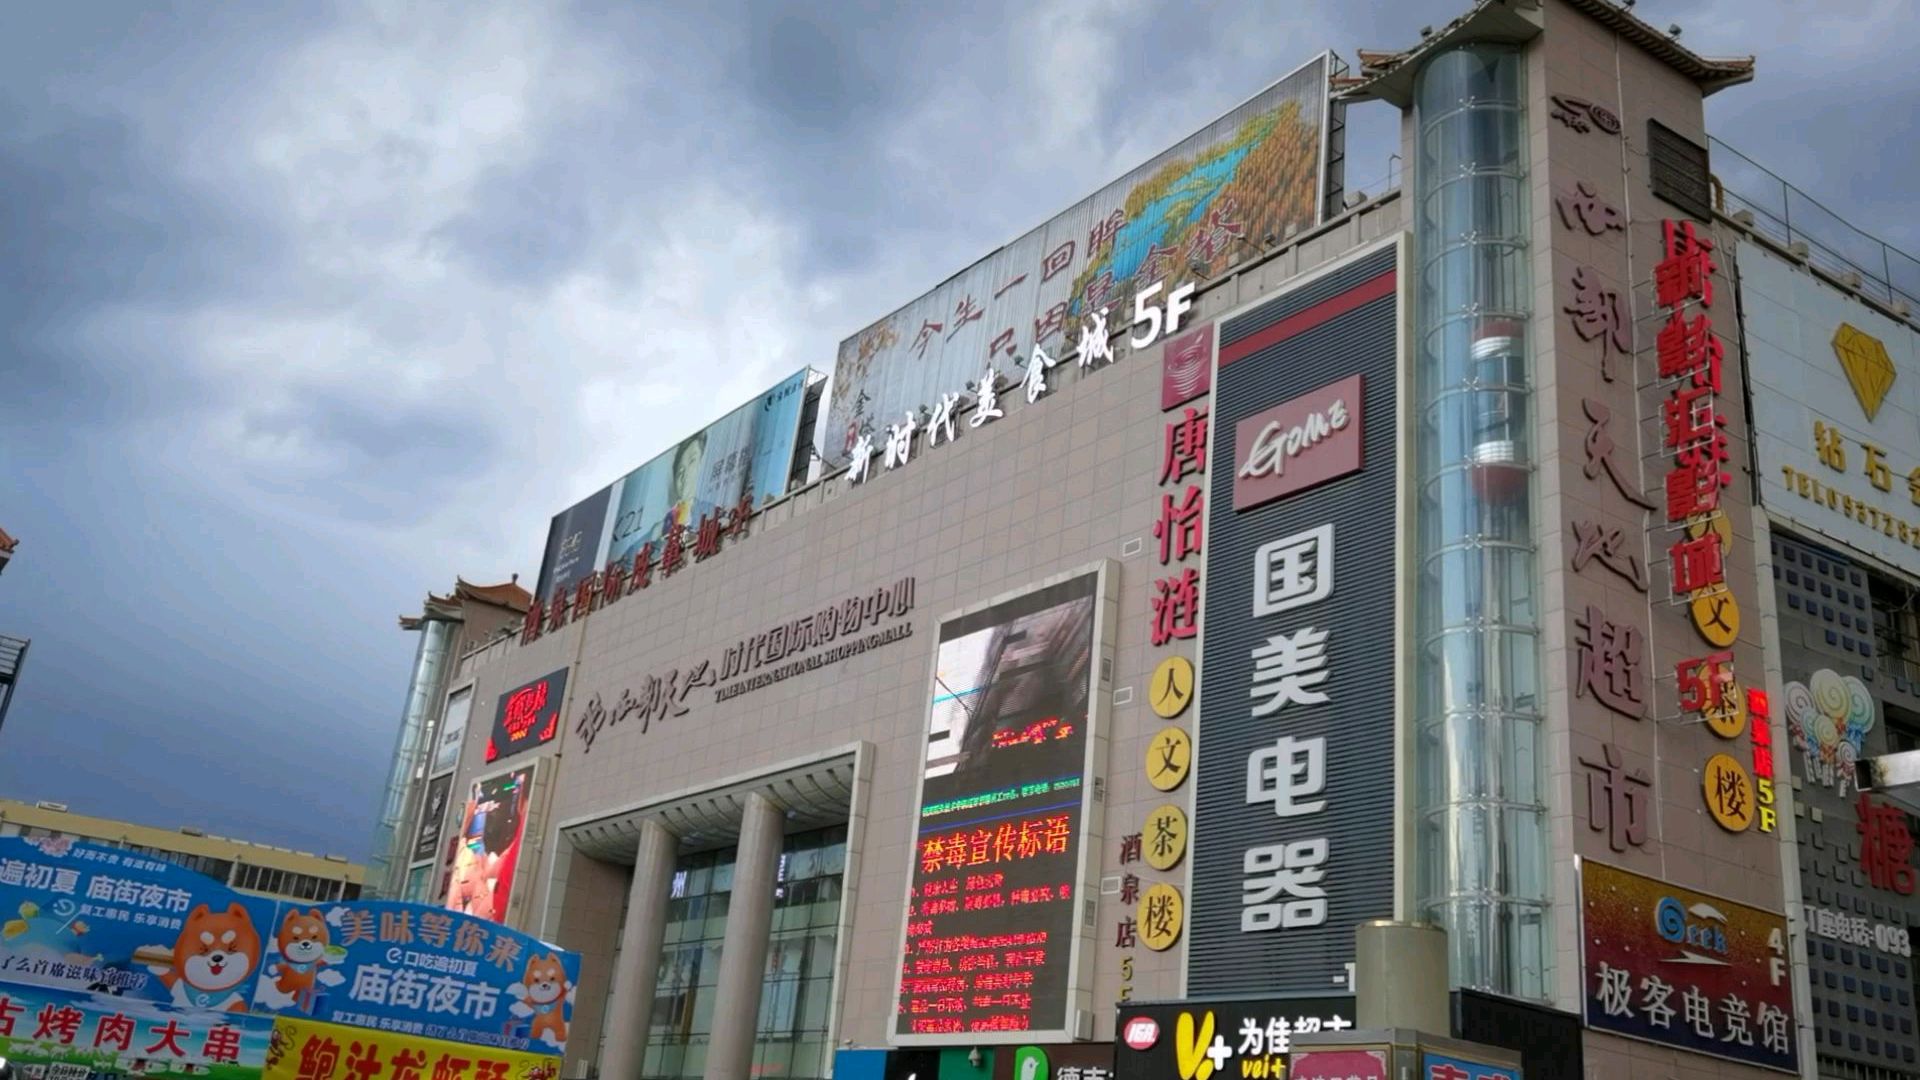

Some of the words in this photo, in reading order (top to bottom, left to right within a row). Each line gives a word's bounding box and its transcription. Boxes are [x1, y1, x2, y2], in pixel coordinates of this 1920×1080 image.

[844, 307, 1114, 484] 新时代美食城
[1131, 281, 1197, 351] 5F
[721, 577, 915, 681] 时代国际购物中心
[1241, 523, 1335, 932] 国美电器
[921, 816, 1071, 873] 禁毒宣传标语
[1115, 832, 1142, 948] 酒泉店
[86, 875, 193, 913] 庙街夜市
[340, 909, 523, 974] 美味等你来
[349, 963, 501, 1020] 庙街夜市
[1596, 962, 1790, 1056] 极客电竞馆
